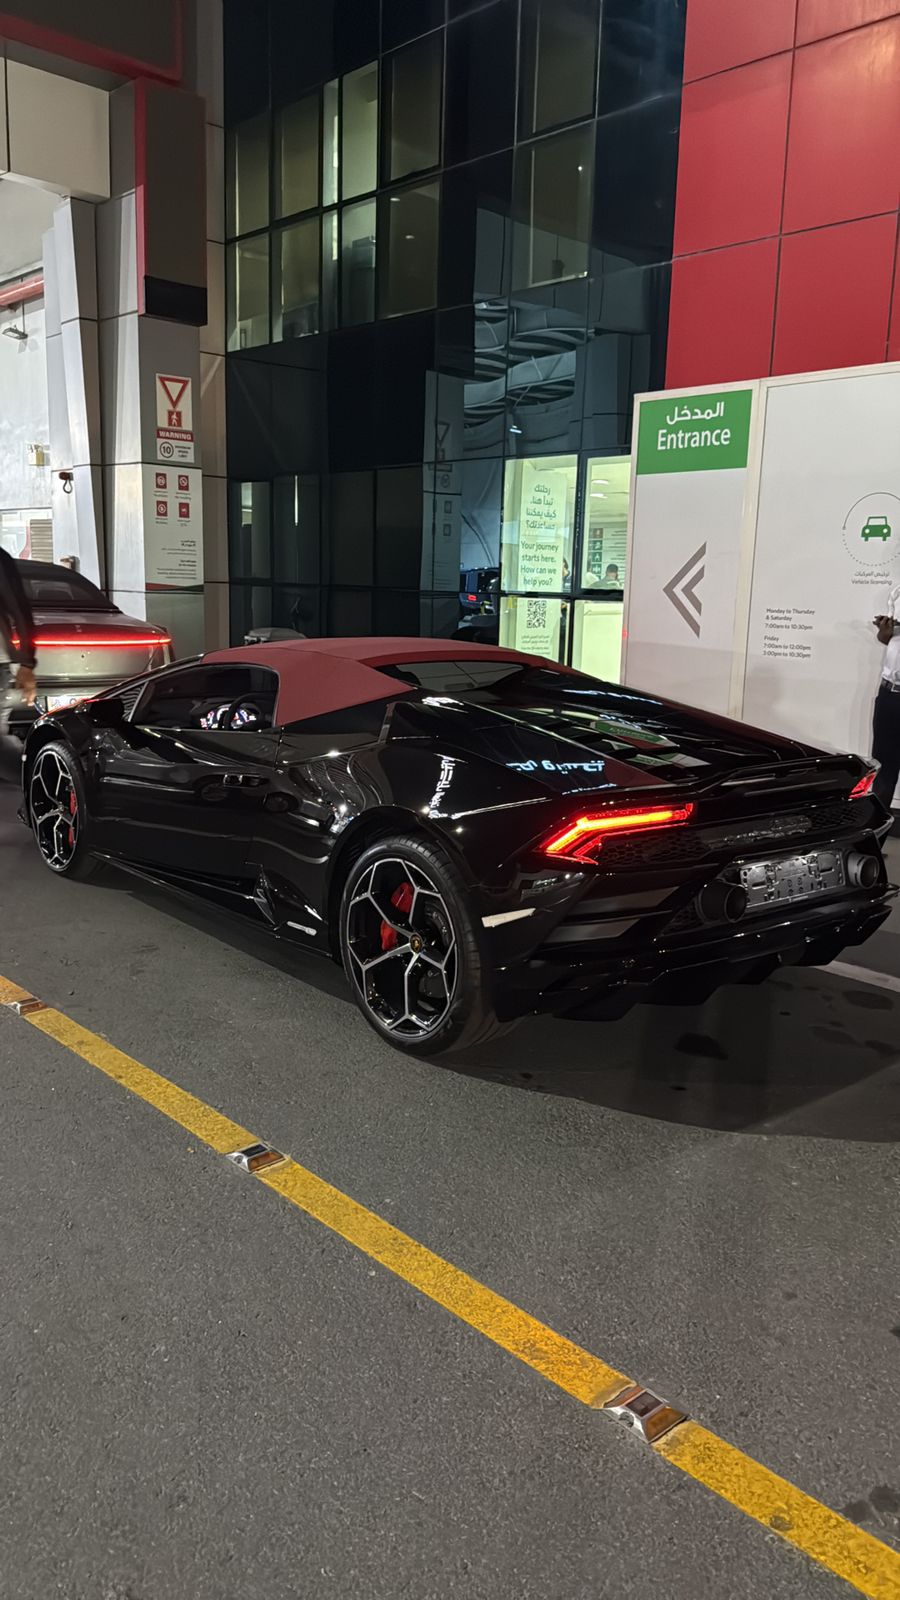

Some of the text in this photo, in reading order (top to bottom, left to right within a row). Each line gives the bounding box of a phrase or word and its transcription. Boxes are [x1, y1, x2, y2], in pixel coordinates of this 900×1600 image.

[666, 401, 725, 425] المدخل
[159, 430, 192, 441] WARNING
[657, 428, 731, 451] Entrance
[162, 446, 172, 455] 10
[534, 484, 551, 495] رحلتك
[543, 495, 554, 507] تبدأ
[526, 507, 557, 520] كيف يمكننا
[520, 541, 559, 552] Your journey
[541, 555, 557, 563] here.
[520, 565, 557, 575] How can we
[523, 577, 553, 587] help you?
[792, 608, 816, 616] Thursday
[789, 651, 811, 659] 10:30pm
